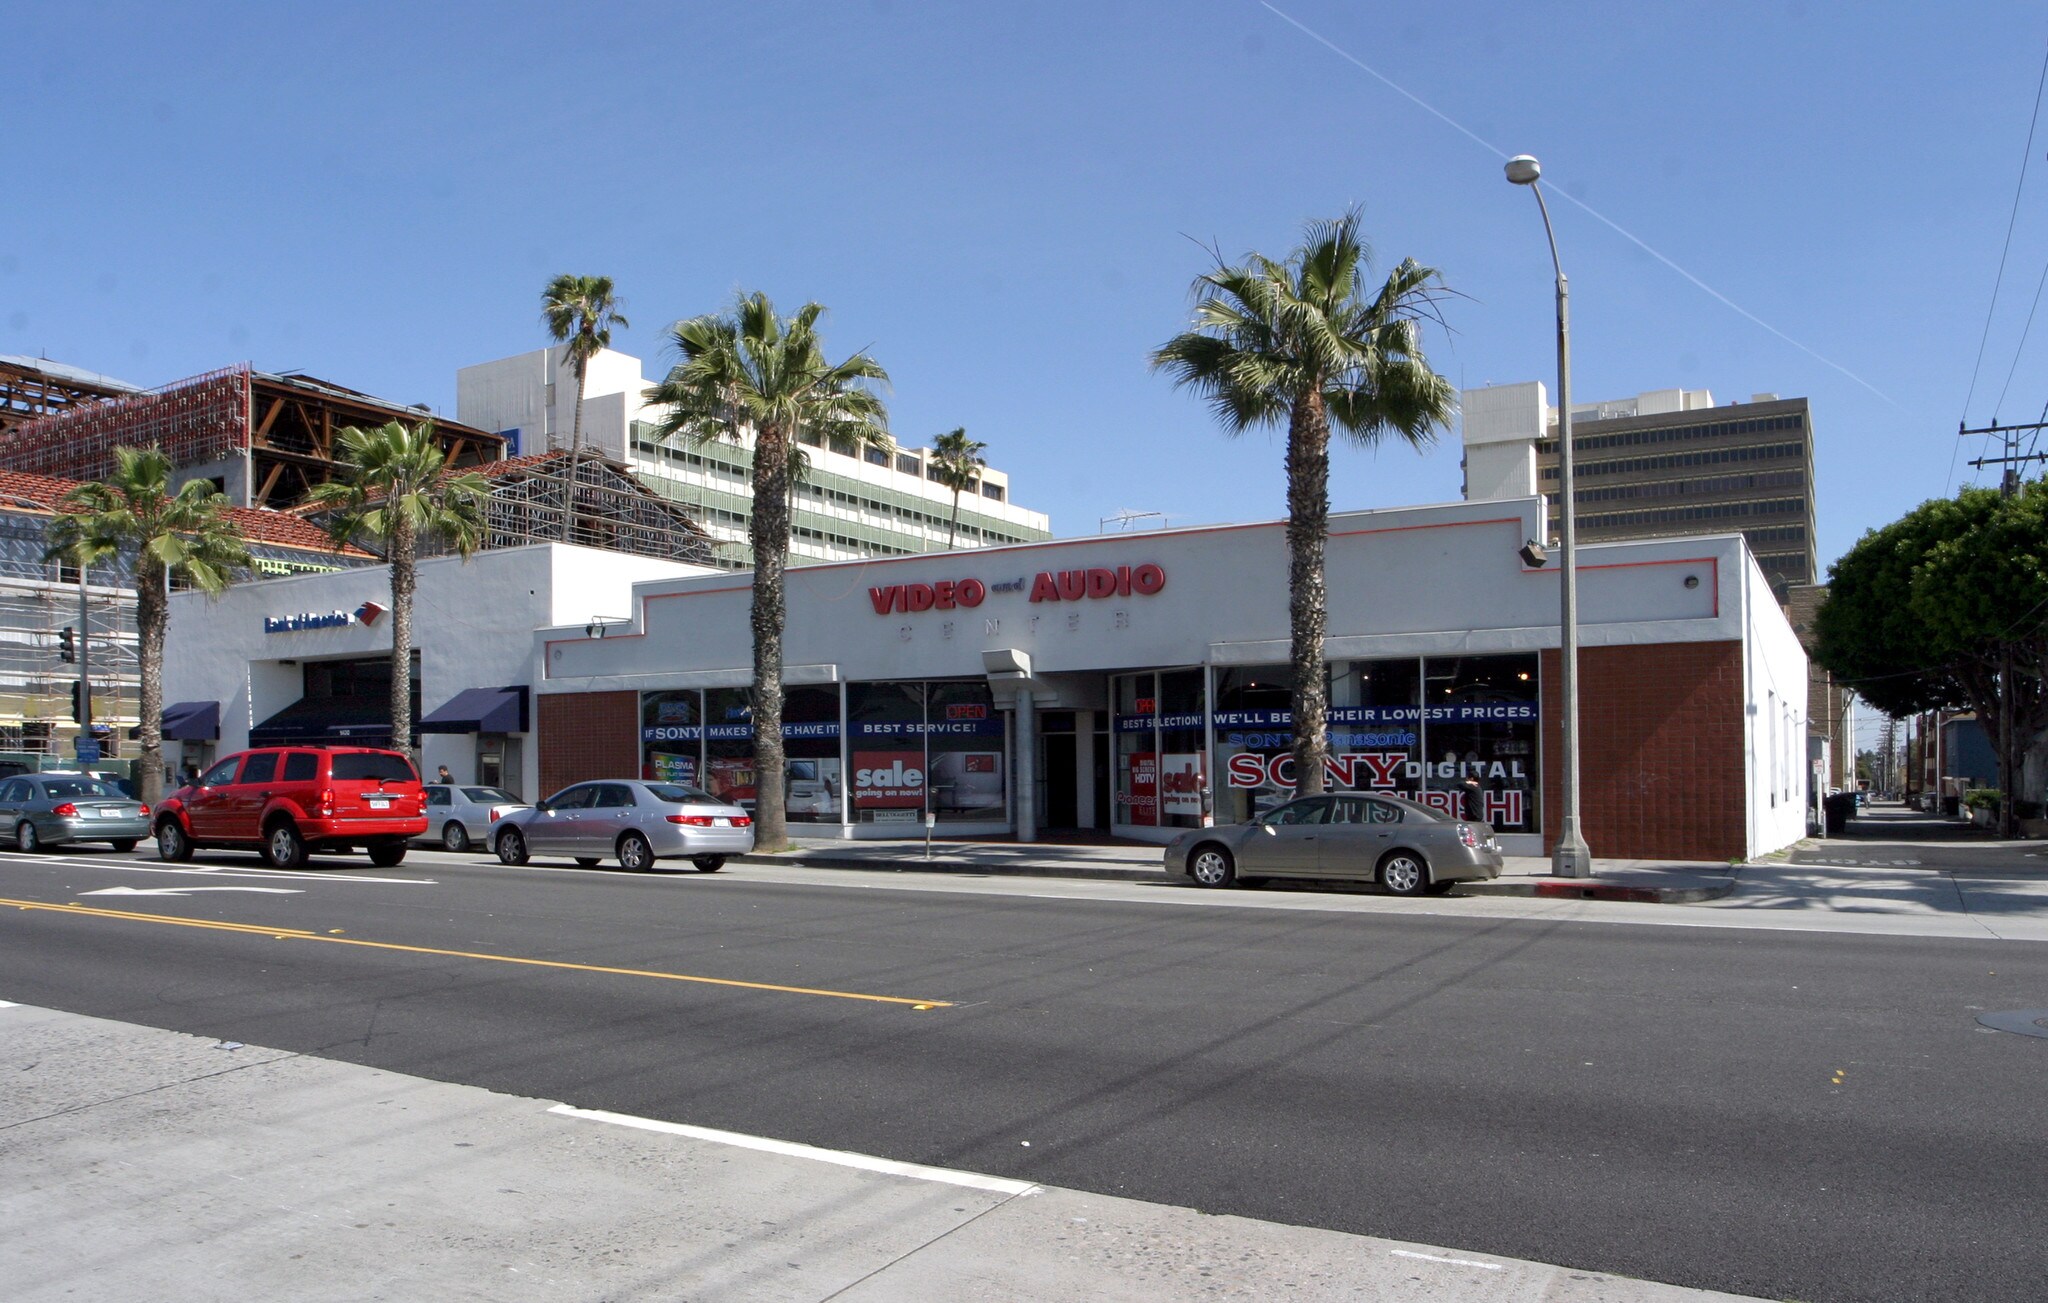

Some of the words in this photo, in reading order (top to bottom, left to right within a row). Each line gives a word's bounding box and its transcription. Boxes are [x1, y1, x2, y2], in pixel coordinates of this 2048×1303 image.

[868, 578, 985, 615] VIDEO
[991, 577, 1025, 593] and
[1029, 563, 1165, 602] AUDIO
[948, 705, 985, 718] OPEN
[1214, 713, 1264, 724] WE'LL
[1325, 710, 1375, 721] THEIR
[1382, 708, 1454, 720] LOWEST
[1461, 706, 1537, 718] PRICES.
[863, 724, 901, 733] BEST
[906, 723, 976, 732] SERVICE!
[1123, 719, 1144, 729] BEST
[645, 729, 653, 738] IF
[656, 727, 701, 739] SONY
[710, 726, 747, 736] MAKES
[794, 725, 824, 735] HAVE
[827, 724, 840, 734] IT!
[655, 760, 694, 770] PLASMA
[1228, 752, 1408, 789] SONY
[1405, 761, 1525, 778] DIGITAL
[855, 760, 924, 787] sale
[1135, 773, 1154, 783] HDTV
[855, 788, 883, 798] going
[899, 788, 923, 796] now!
